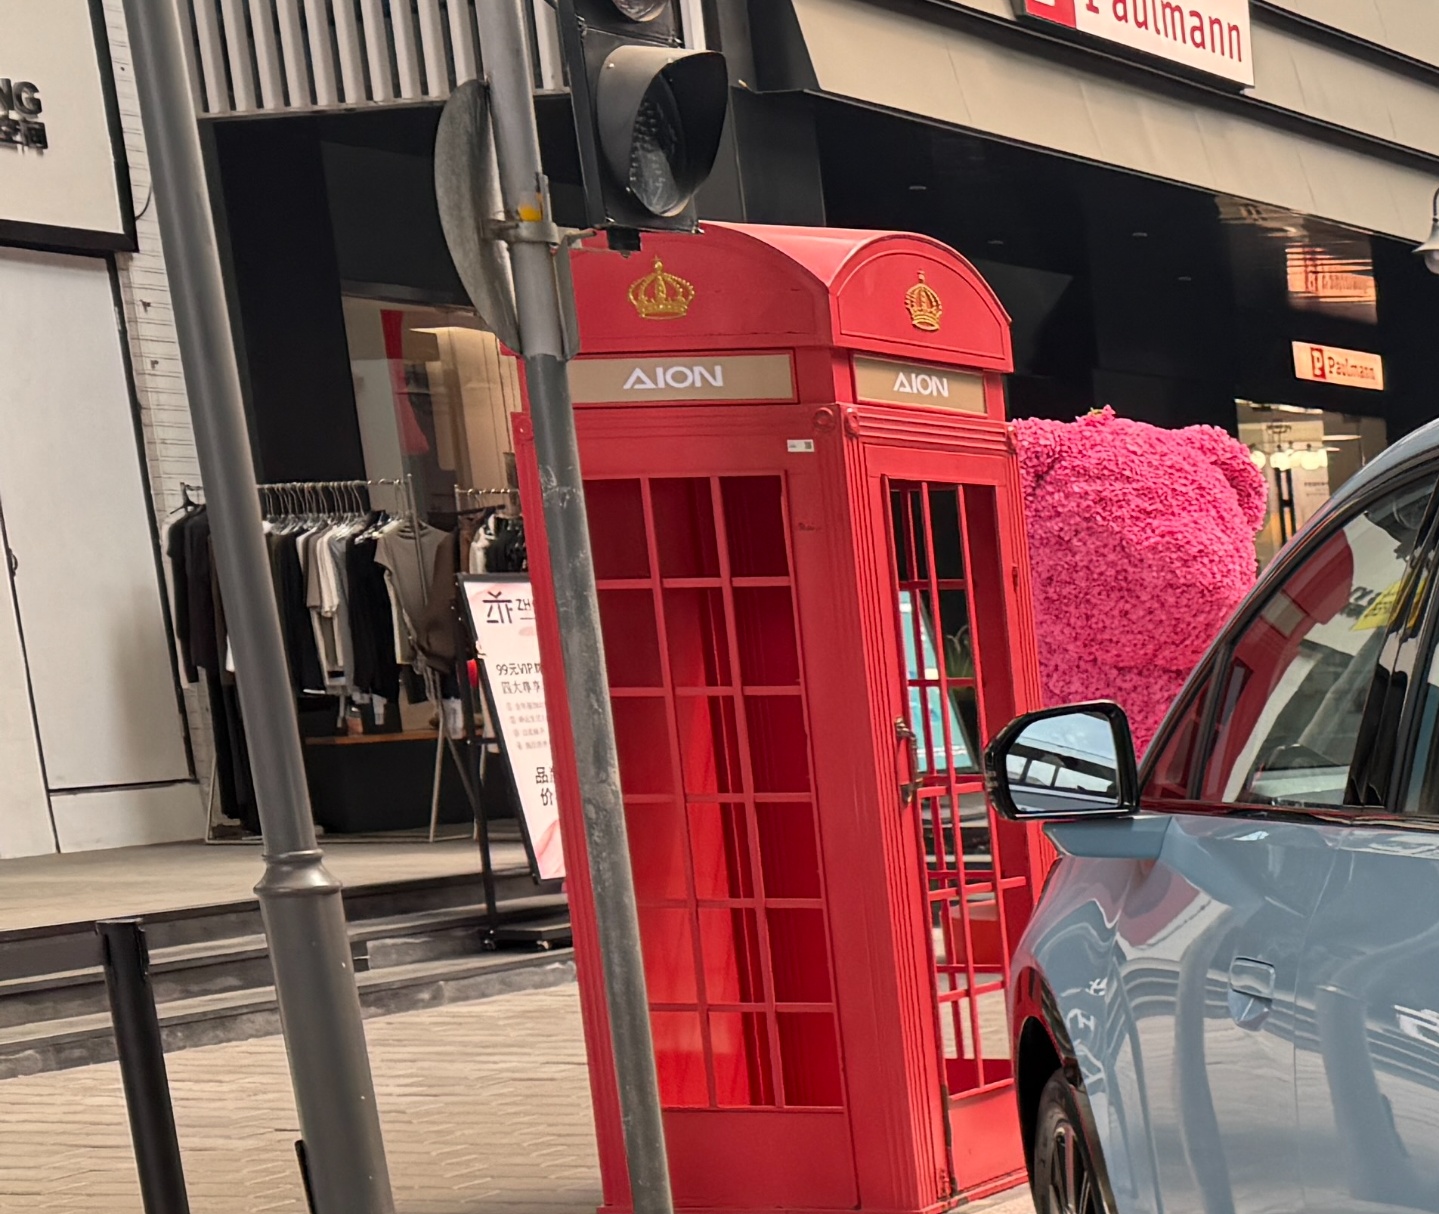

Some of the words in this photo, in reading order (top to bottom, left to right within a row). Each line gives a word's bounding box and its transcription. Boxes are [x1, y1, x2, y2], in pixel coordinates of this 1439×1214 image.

[1086, 0, 1242, 62] aulmann
[623, 365, 724, 390] AION
[1328, 355, 1376, 381] Paulmann
[893, 372, 949, 398] AION
